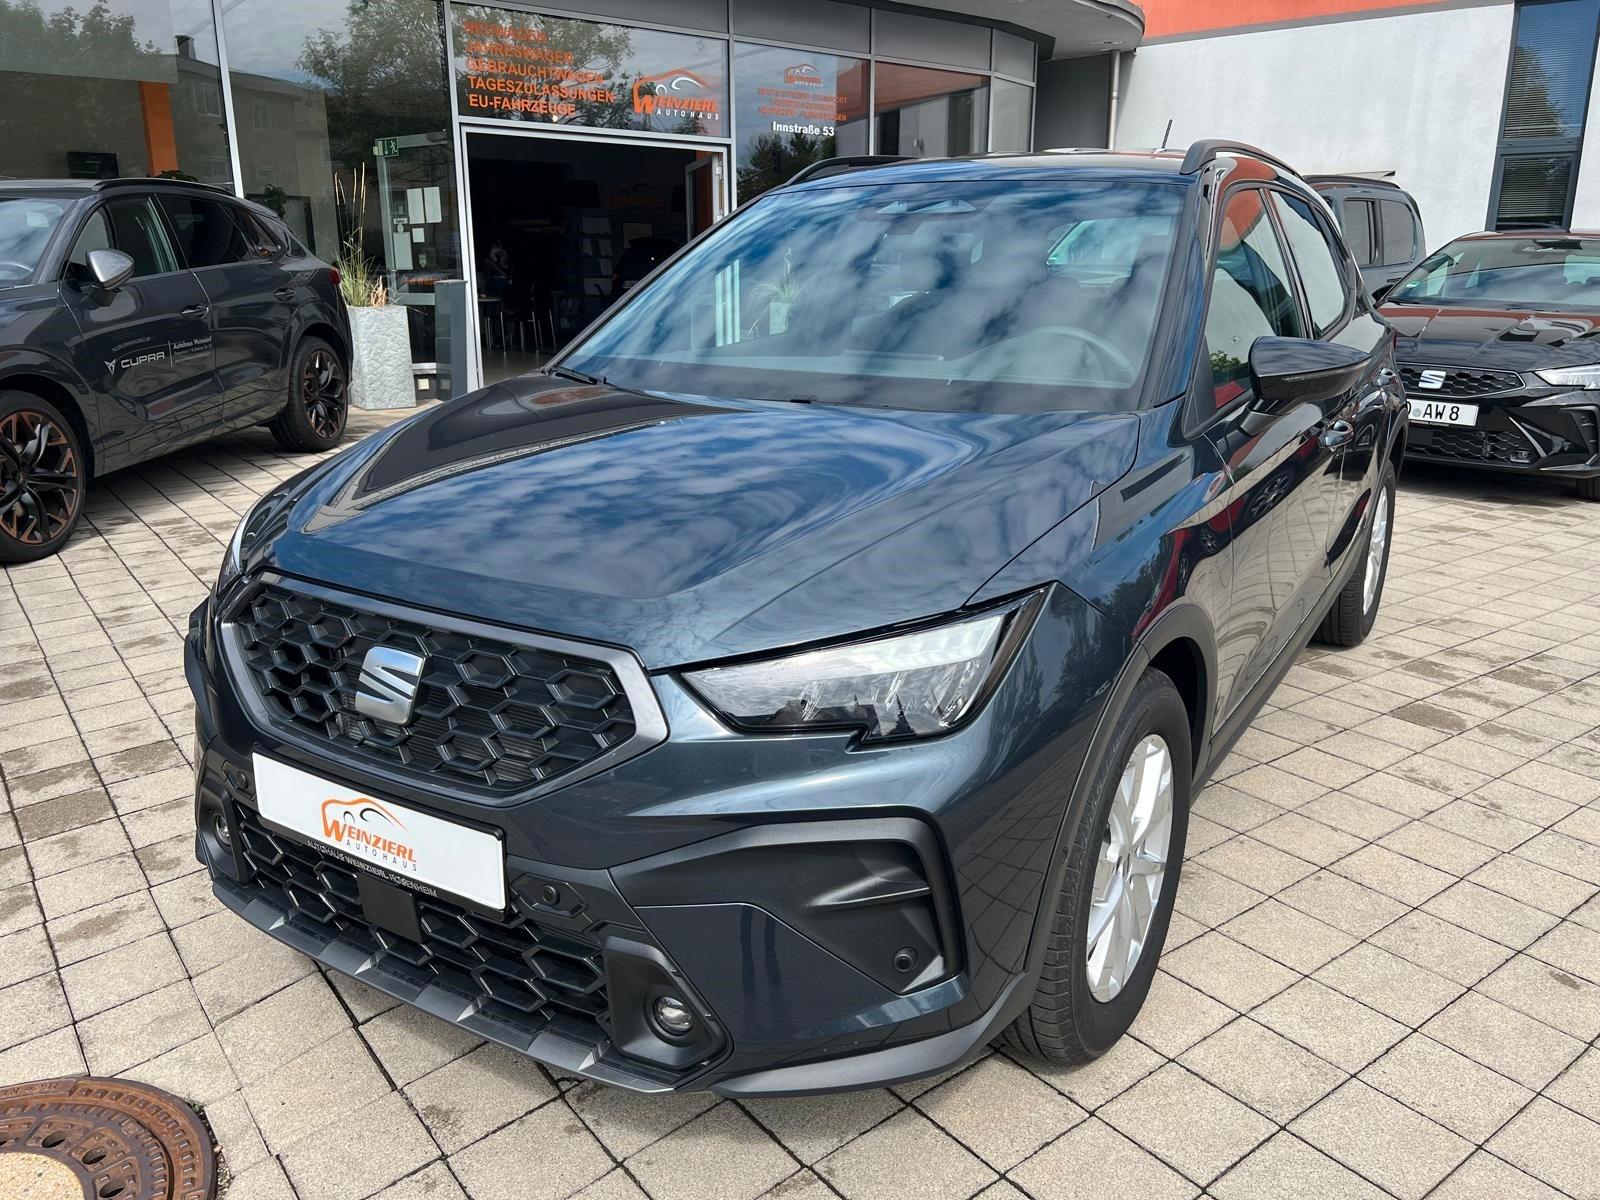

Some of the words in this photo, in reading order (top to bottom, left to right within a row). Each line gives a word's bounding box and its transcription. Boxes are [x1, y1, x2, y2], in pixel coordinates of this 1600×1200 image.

[466, 57, 604, 84] GEBRAUCHTWAGEN
[468, 76, 614, 103] TAGESZULASSUNGEN
[469, 94, 576, 116] EU-FAHRZEUGE
[633, 94, 718, 114] WEINZIERL
[656, 108, 719, 120] AUTOHAUS
[772, 121, 820, 135] Innstraße
[822, 126, 835, 137] 53
[121, 351, 166, 369] CUPRA
[1423, 403, 1447, 420] AW
[1449, 406, 1460, 421] 8
[323, 819, 417, 863] WEINZIERL
[346, 839, 418, 872] AUTOHAUS
[307, 840, 345, 861] AUTOHAUS
[345, 855, 389, 879] WEINZIERL
[388, 873, 438, 898] ROSENHEIM
